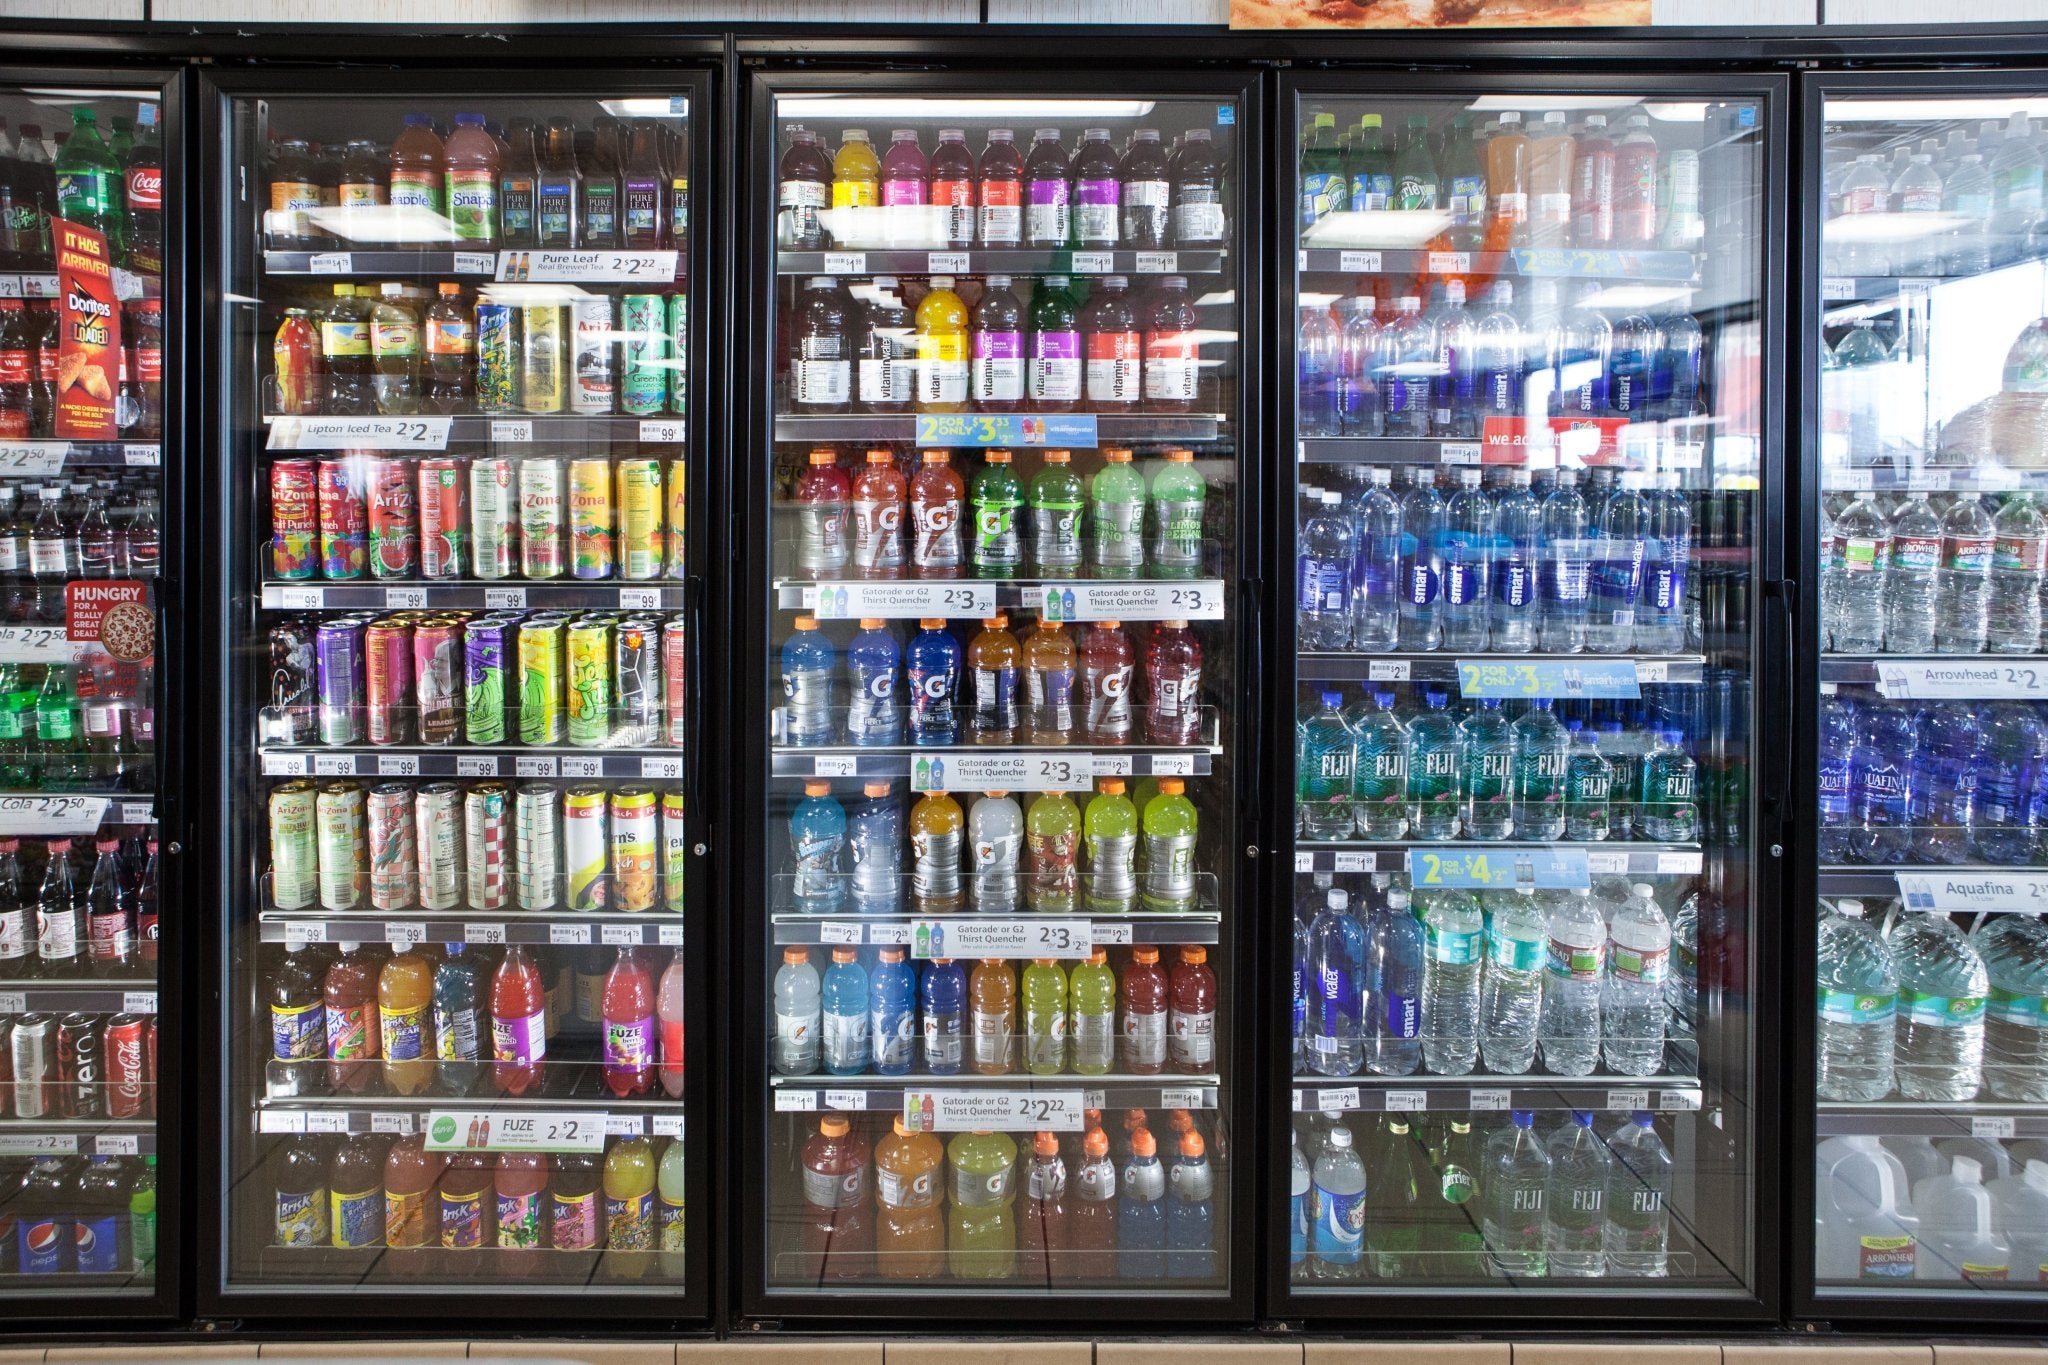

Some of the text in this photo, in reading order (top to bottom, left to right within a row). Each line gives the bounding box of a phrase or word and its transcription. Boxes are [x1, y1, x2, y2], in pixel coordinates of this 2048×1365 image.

[630, 194, 653, 202] PURE
[65, 231, 100, 254] IT HAS
[61, 252, 110, 278] ARRIVED
[542, 254, 600, 264] Pure Leaf
[68, 292, 111, 318] Doritos
[73, 323, 109, 345] LOADED
[1496, 373, 1508, 409] smart
[1619, 376, 1631, 411] smart
[306, 424, 392, 435] Lipton Iced Tea
[920, 416, 964, 442] 2 FOR
[938, 426, 974, 436] ONLY
[1489, 434, 1510, 446] we
[879, 506, 898, 530] G
[926, 506, 948, 531] G
[981, 512, 1001, 534] G
[862, 588, 929, 596] Gatorade or G2
[1414, 565, 1428, 604] smart
[1451, 565, 1463, 605] smart
[1510, 567, 1525, 606] smart
[1658, 570, 1671, 608] smart
[74, 587, 141, 602] HUNGRY
[862, 596, 932, 605] Thirst Quencher
[944, 590, 954, 604] 2
[1088, 589, 1130, 597] Gatorade
[1171, 590, 1182, 604] 2
[74, 602, 98, 610] FOR A
[1088, 598, 1159, 607] Thirst Quencher
[74, 612, 103, 620] REALLY
[74, 620, 100, 628] GREAT
[20, 629, 32, 643] 2
[74, 630, 100, 638] DEAL?
[1462, 665, 1508, 694] 2 FOR
[1483, 676, 1517, 686] ONLY
[1925, 668, 2017, 683] Arrowhead 2
[925, 674, 946, 698] G
[958, 759, 998, 767] Gatorade
[1040, 761, 1050, 776] 2
[1321, 755, 1350, 776] FIJI
[1376, 755, 1404, 776] FIJI
[1426, 754, 1455, 774] FIJI
[1483, 755, 1511, 776] FIJI
[1538, 754, 1566, 776] FIJI
[958, 768, 1028, 778] Thirst Quencher
[1582, 778, 1608, 796] FIJI
[1666, 777, 1691, 796] FIJI
[1, 798, 50, 812] Cola 2
[1422, 854, 1442, 884] 2
[1946, 882, 2014, 896] Aquafina
[958, 925, 998, 934] Gatorade
[1040, 927, 1050, 942] 2
[958, 934, 1028, 944] Thirst Quencher
[1326, 968, 1338, 1000] water
[1404, 998, 1415, 1038] smart
[610, 1027, 642, 1038] FUZE
[76, 1036, 95, 1100] zero
[942, 1097, 1009, 1106] Gatorade or G2
[1019, 1098, 1030, 1115] 2
[942, 1106, 1012, 1117] Thirst Quencher
[503, 1119, 534, 1131] FUZE
[547, 1125, 557, 1140] 2
[1514, 1190, 1544, 1210] FIJI
[1572, 1190, 1602, 1211] FIJI
[1633, 1192, 1662, 1212] FIJI
[1866, 1252, 1914, 1262] ARROWHEAD
